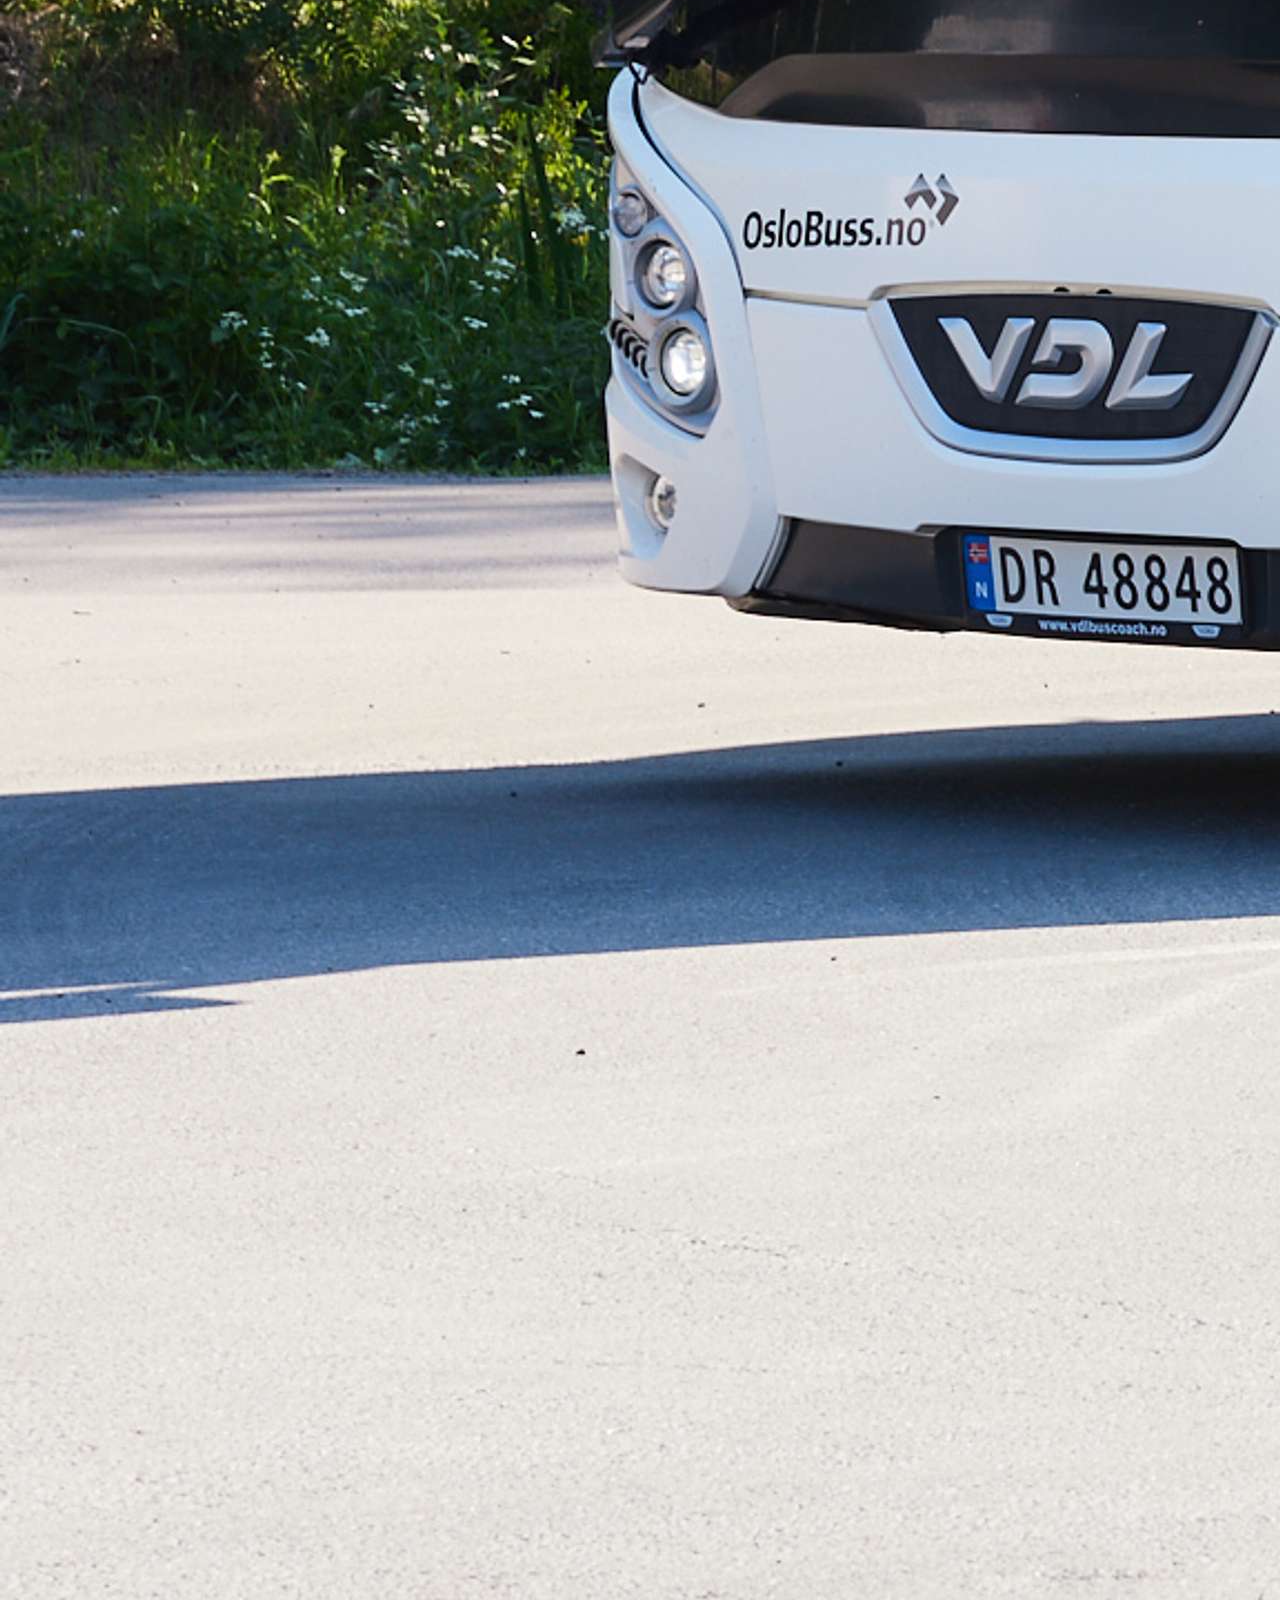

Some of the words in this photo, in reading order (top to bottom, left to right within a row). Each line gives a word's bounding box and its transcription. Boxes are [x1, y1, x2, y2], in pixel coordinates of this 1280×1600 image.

[743, 208, 926, 250] OsloBuss.no
[938, 316, 1194, 411] VDL
[975, 581, 988, 599] N
[998, 546, 1060, 606] DR
[1083, 552, 1233, 615] 48848
[1038, 618, 1168, 637] www.vdlbuscoach.no
